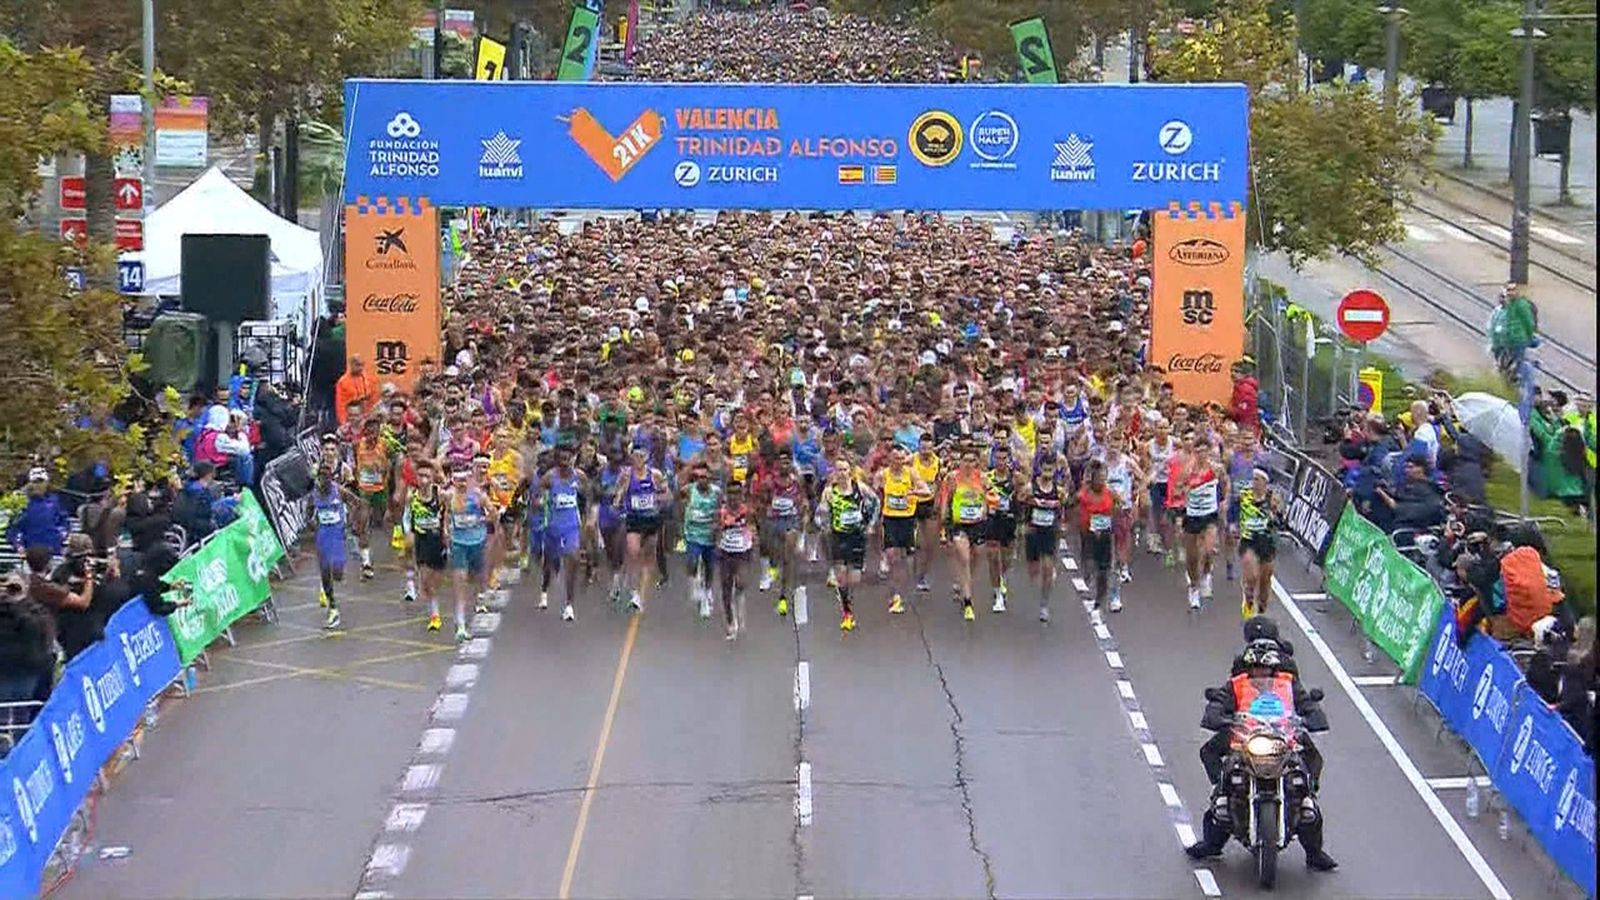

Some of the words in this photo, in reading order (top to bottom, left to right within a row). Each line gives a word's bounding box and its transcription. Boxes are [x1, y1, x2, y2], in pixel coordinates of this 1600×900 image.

[566, 25, 592, 64] 2
[675, 107, 779, 130] VALENCIA
[613, 122, 654, 169] 21K
[675, 136, 782, 156] TRINIDAD
[788, 138, 898, 158] ALFONSO
[370, 151, 440, 163] TRINIDAD
[369, 163, 440, 176] ALFONSO
[707, 165, 778, 183] ZURICH
[1132, 162, 1219, 181] ZURICH
[119, 266, 142, 288] 14
